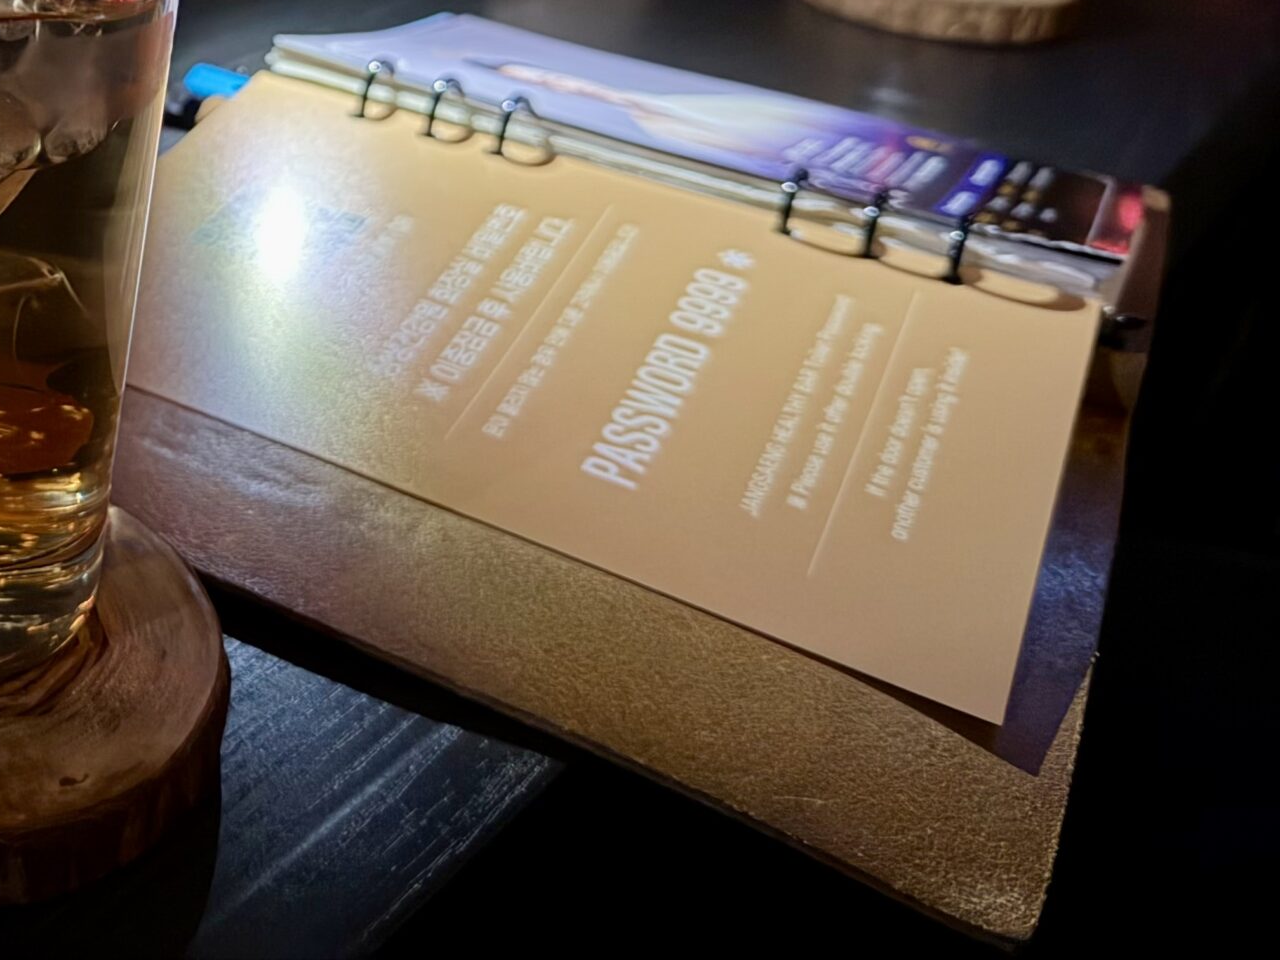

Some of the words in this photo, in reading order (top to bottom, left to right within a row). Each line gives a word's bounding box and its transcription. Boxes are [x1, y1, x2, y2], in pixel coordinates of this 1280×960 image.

[423, 314, 501, 383] 이중잠금
[577, 331, 714, 490] PASSWORD
[664, 265, 750, 338] 9999
[819, 393, 851, 424] after
[923, 389, 960, 426] using
[735, 440, 789, 517] JANGSAENG
[768, 391, 809, 444] HEALTHY
[809, 431, 836, 456] use
[875, 434, 905, 465] door
[901, 431, 941, 492] customer
[788, 452, 827, 497] Please
[867, 462, 895, 487] the
[884, 487, 923, 542] another
